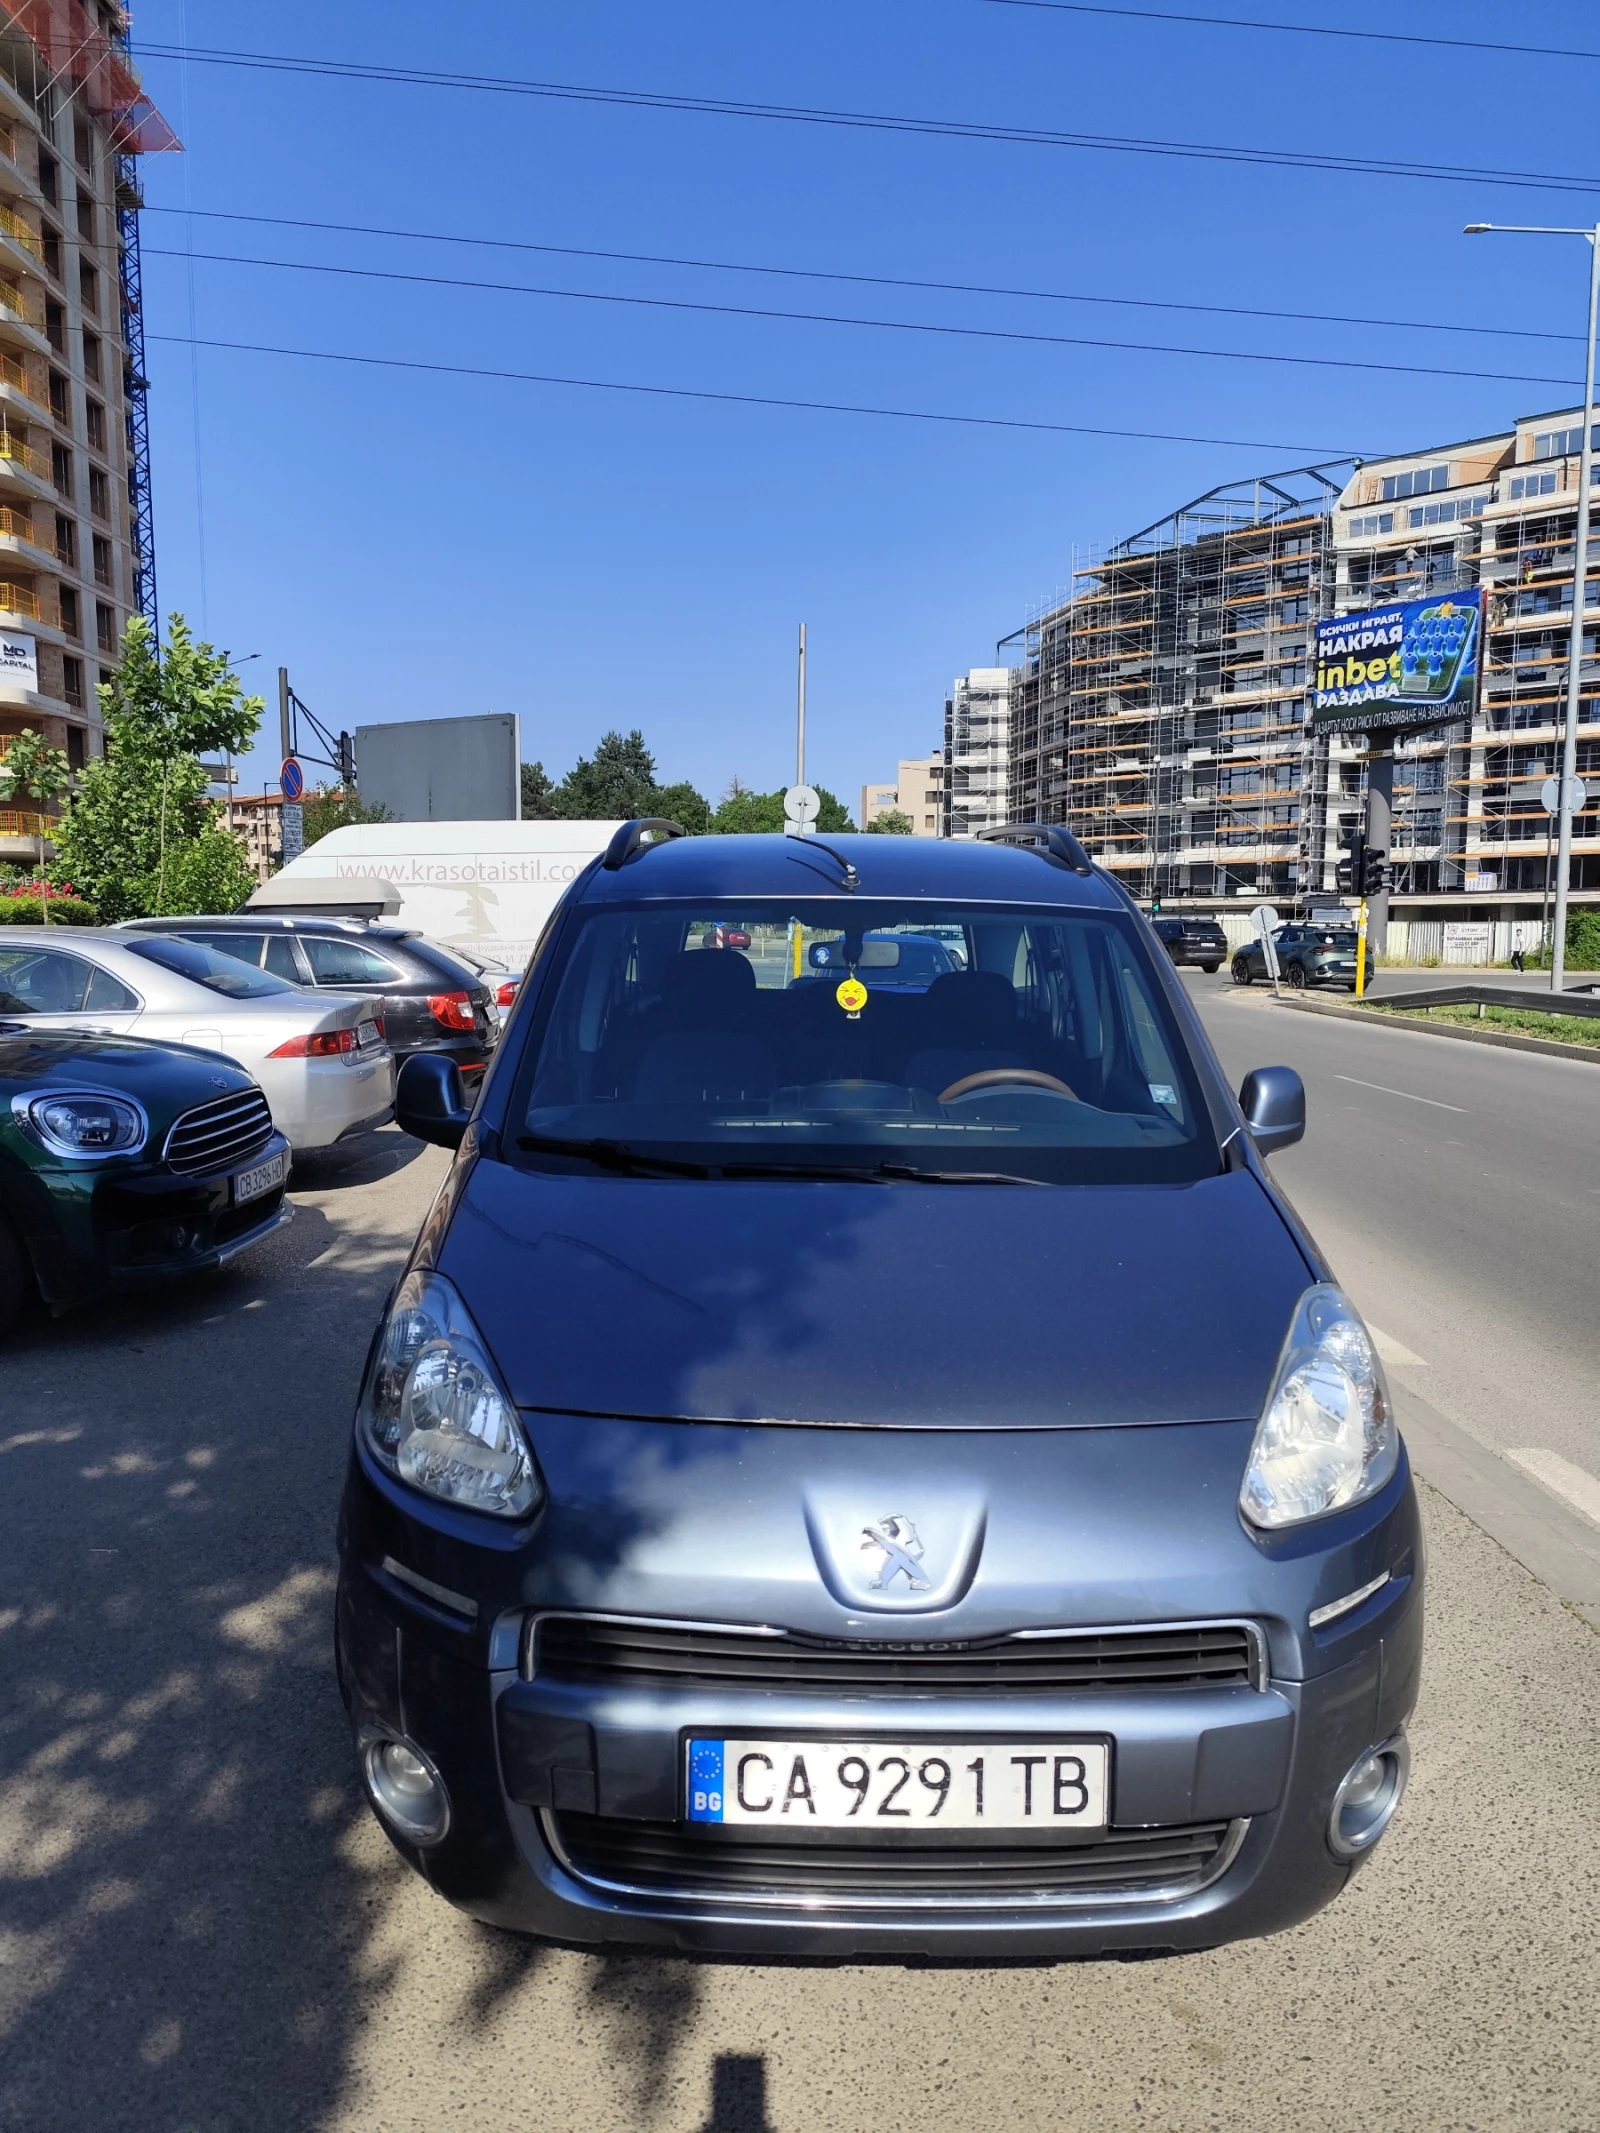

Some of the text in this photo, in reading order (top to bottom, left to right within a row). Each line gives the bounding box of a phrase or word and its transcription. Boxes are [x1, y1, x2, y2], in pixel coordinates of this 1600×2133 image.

[1320, 612, 1403, 637] ВСИЧКИ ИГРАЯТ,
[3, 644, 26, 656] MD
[1319, 625, 1403, 657] НАКРАЯ
[1317, 650, 1401, 691] inbet
[1317, 683, 1400, 708] РАЗДАВА
[1314, 700, 1471, 735] ХАЗАРТЪТ НОСИ РИСК ОТ РАЗВИВАНЕ НА ЗАВИСИМОСТ
[240, 1174, 252, 1197] CB
[825, 1640, 969, 1651] PEUGEOT
[737, 1753, 1089, 1816] CA 9291 TB
[694, 1791, 722, 1811] BG
